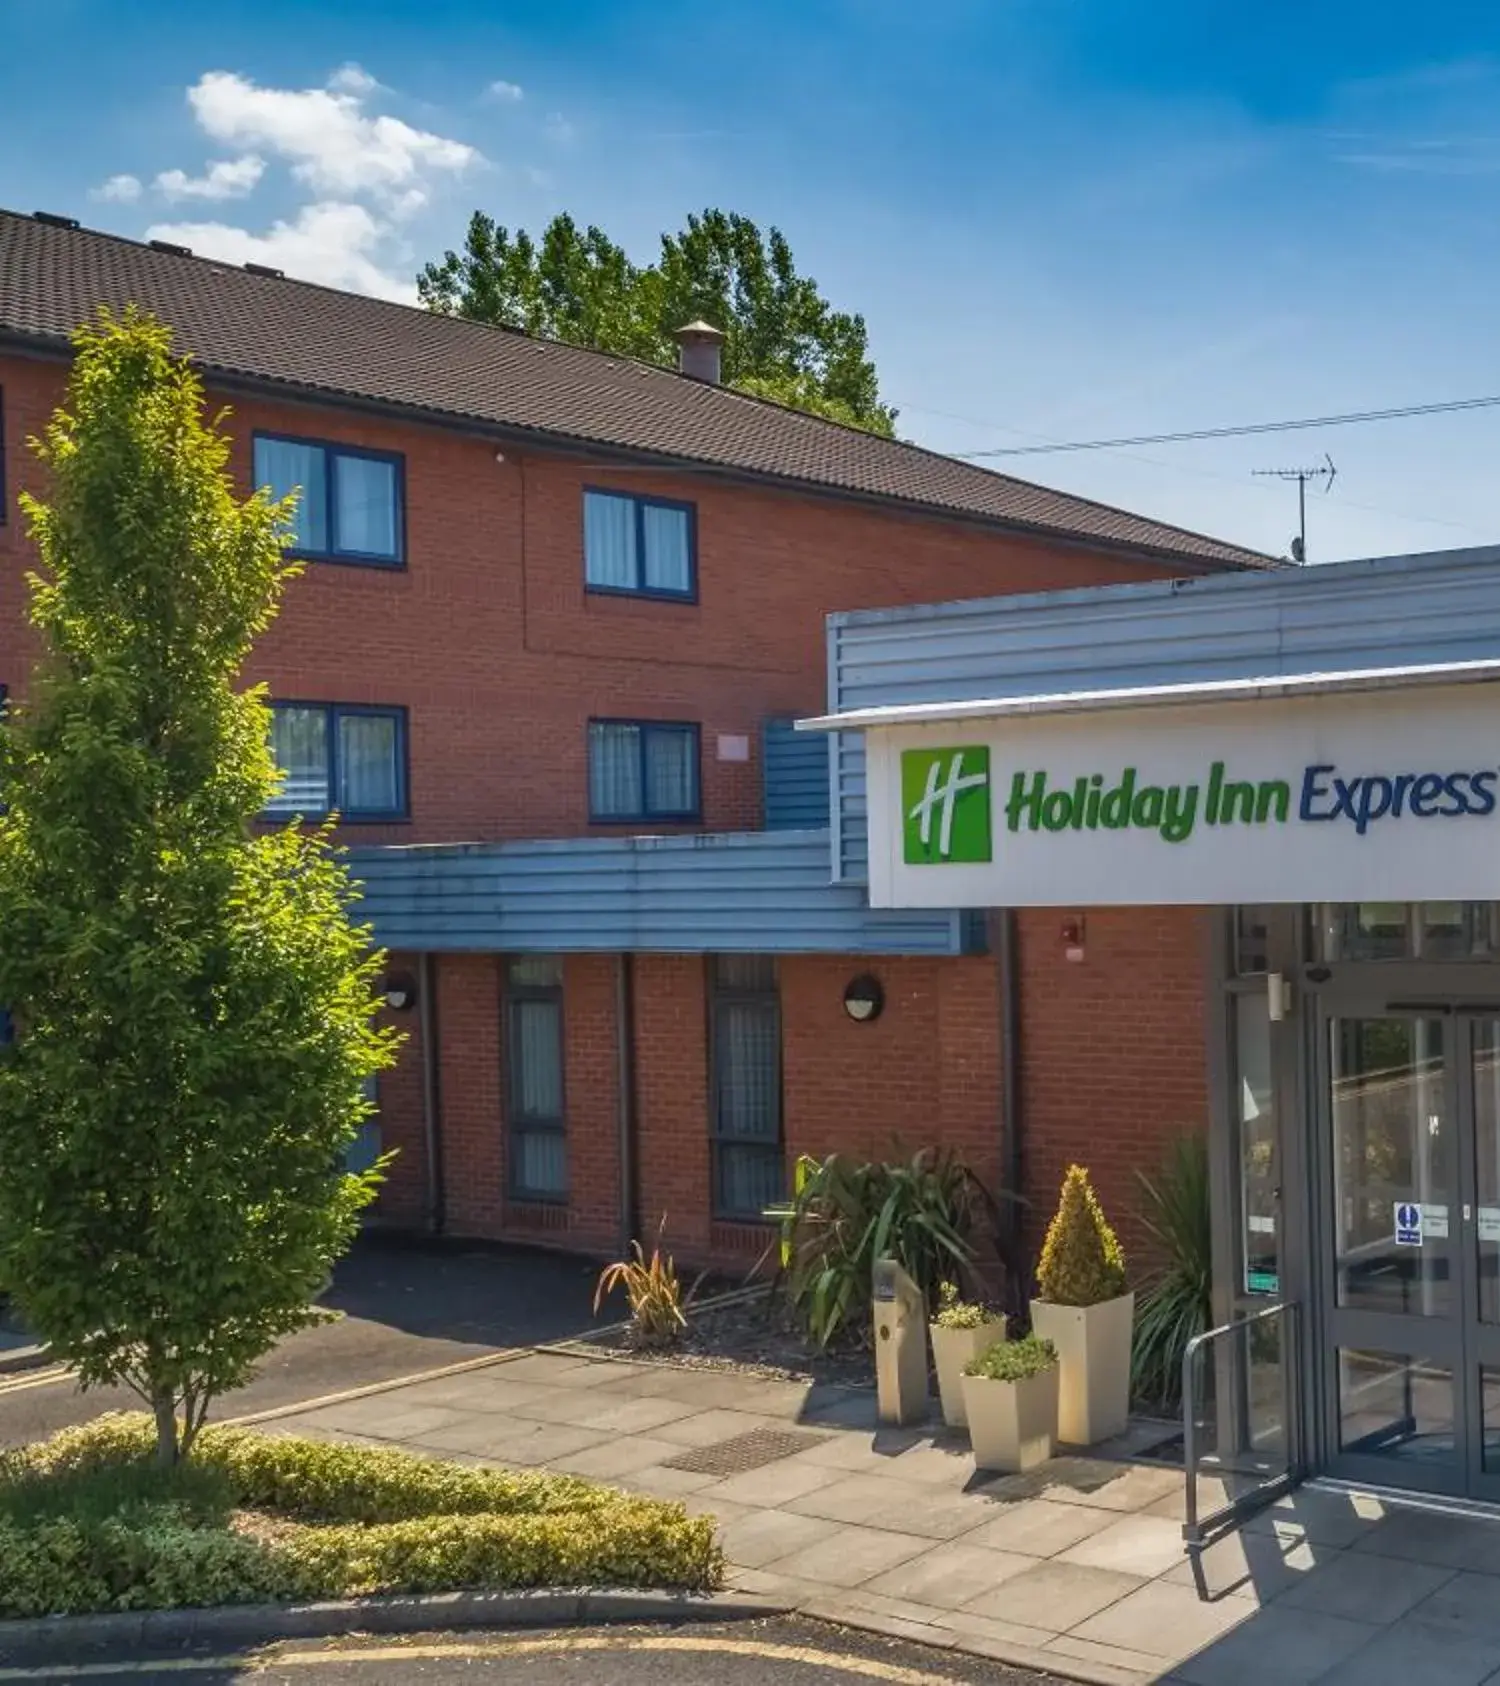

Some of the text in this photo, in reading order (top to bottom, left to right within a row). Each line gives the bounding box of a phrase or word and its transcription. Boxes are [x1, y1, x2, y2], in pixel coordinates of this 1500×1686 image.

[1005, 762, 1497, 841] Holiday Inn Express
